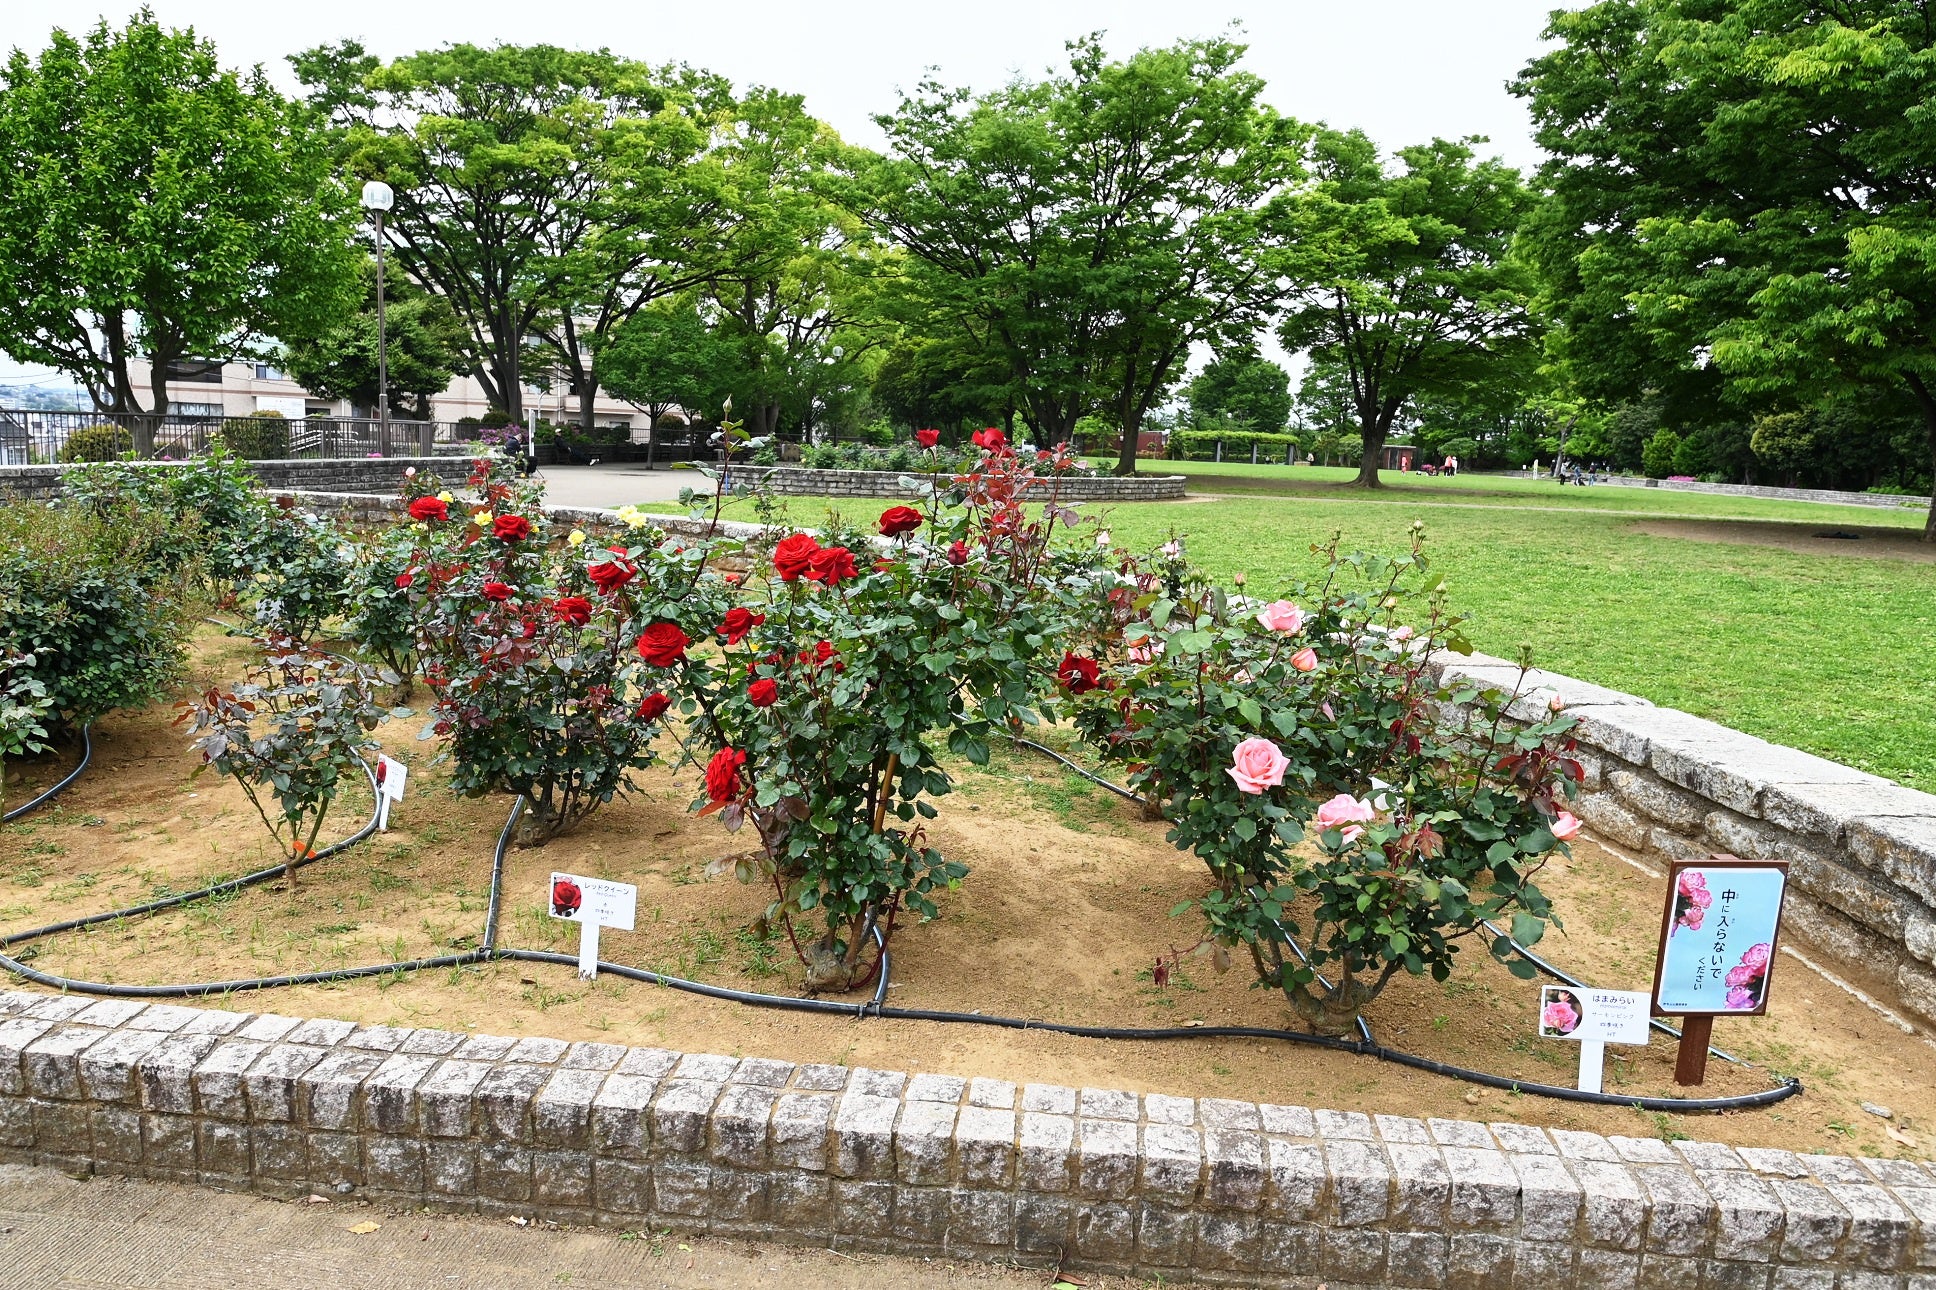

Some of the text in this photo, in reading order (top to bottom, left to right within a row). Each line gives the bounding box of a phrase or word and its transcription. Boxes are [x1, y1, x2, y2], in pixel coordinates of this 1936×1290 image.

[584, 882, 630, 895] レッドクイーン
[1710, 889, 1736, 979] 中に入らないで
[1693, 957, 1706, 990] ください
[1592, 995, 1635, 1005] はまみらい
